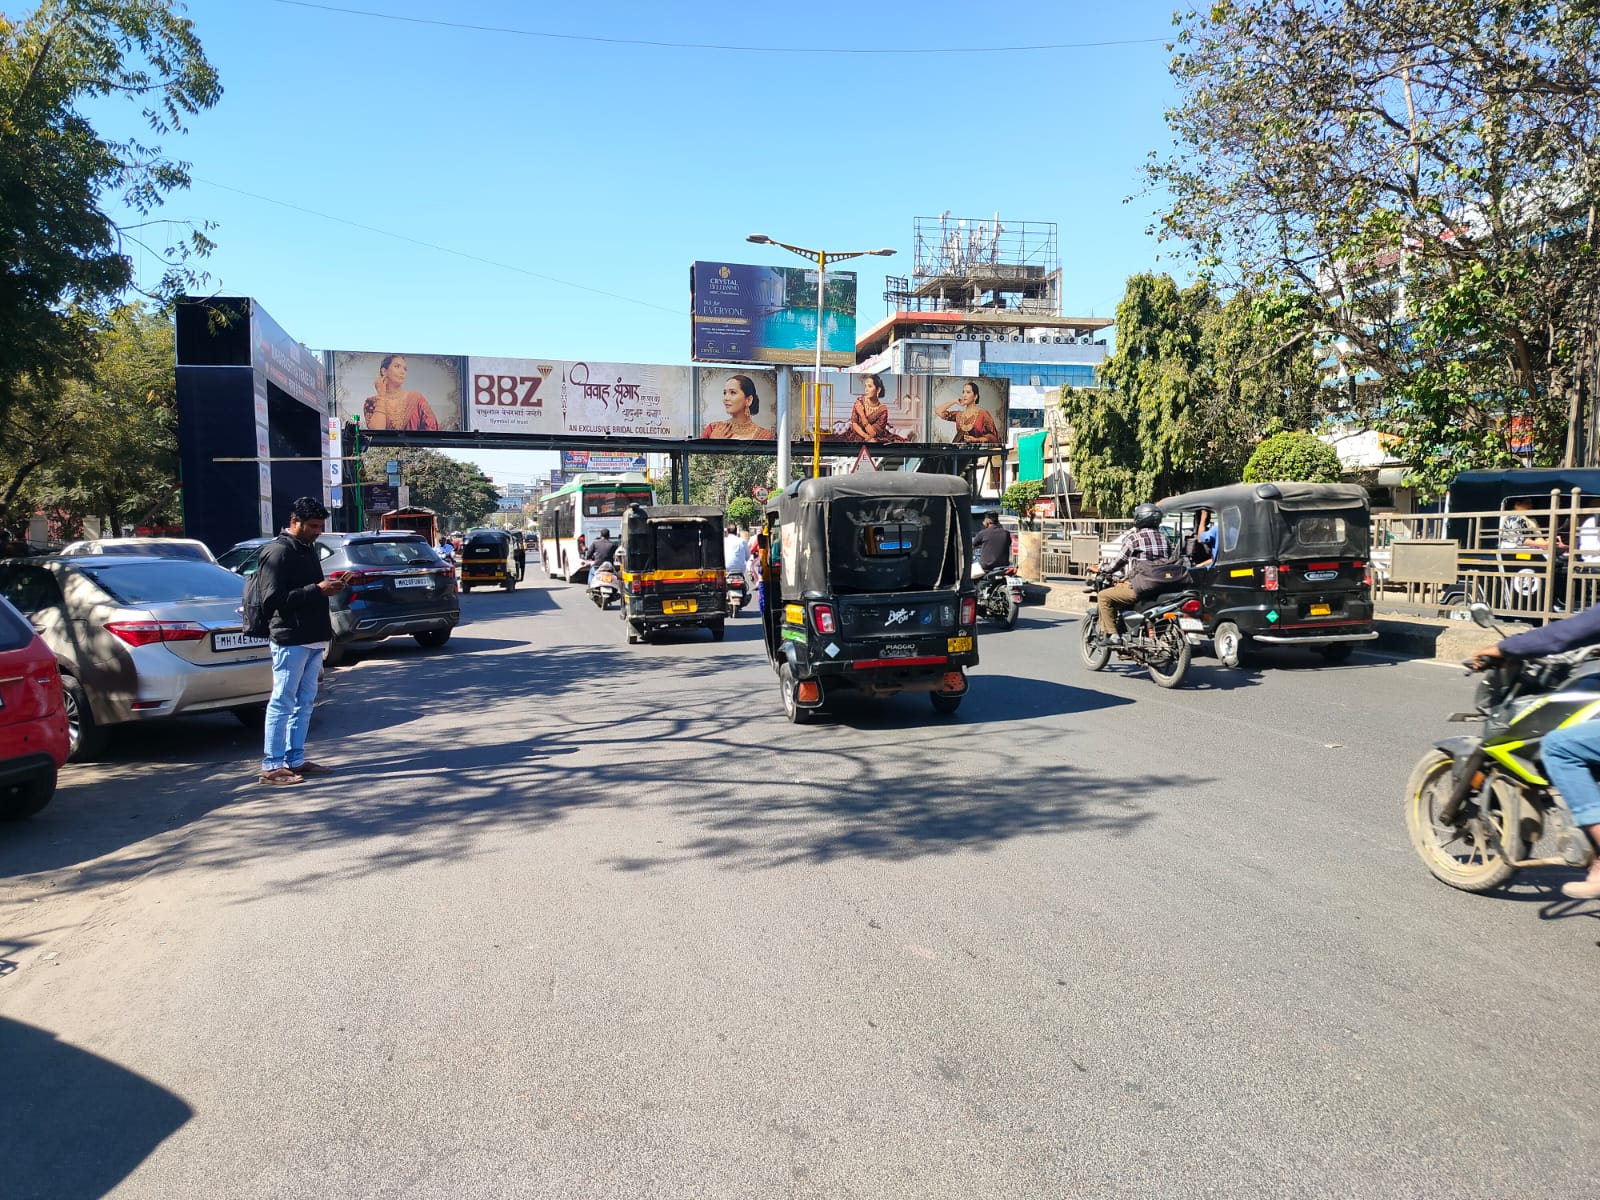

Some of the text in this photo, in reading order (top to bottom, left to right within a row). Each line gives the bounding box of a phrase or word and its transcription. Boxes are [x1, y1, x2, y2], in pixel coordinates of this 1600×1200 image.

[709, 278, 739, 286] CRYSTAL
[703, 305, 745, 317] EVERYONE
[474, 374, 543, 408] BBZ
[568, 424, 671, 435] AN EXCLUSIVE BRIDAL COLLECTION
[885, 643, 916, 651] PIAGGIO
